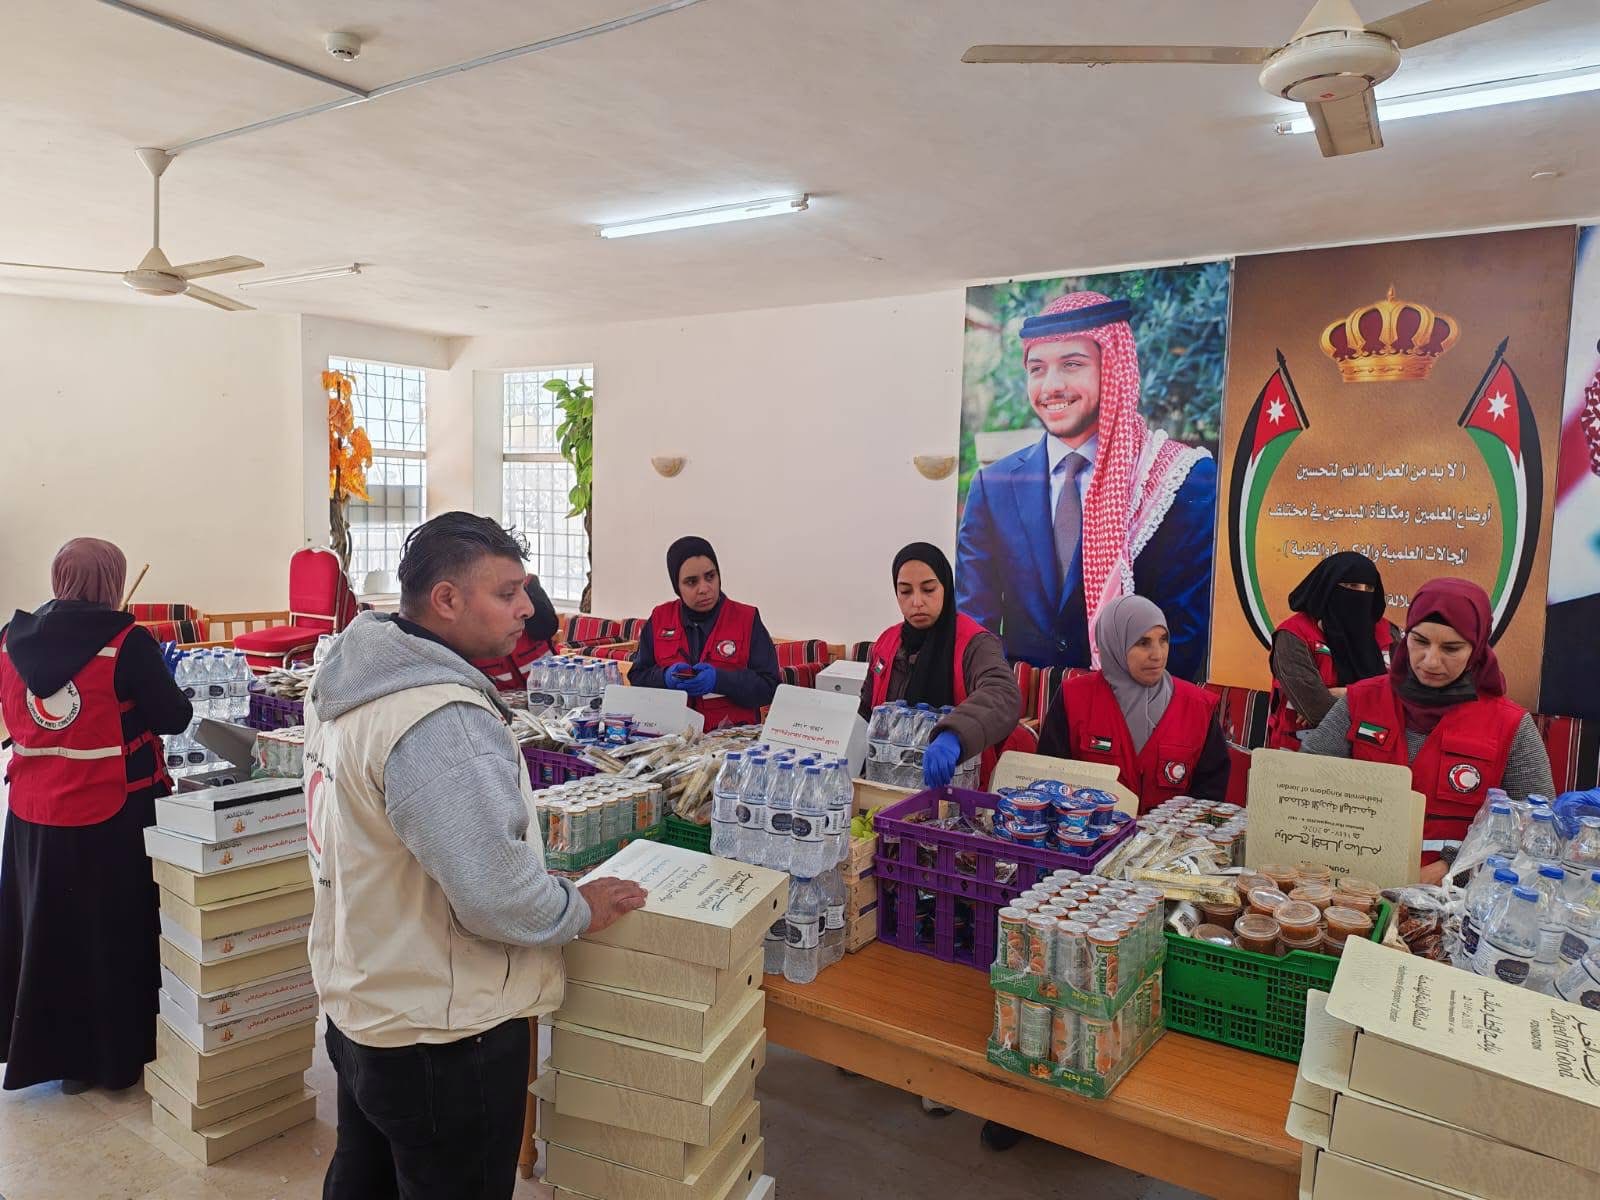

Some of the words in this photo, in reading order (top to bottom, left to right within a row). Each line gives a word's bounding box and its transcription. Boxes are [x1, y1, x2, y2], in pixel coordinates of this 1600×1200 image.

[1296, 463, 1338, 481] لتحسين
[1376, 463, 1409, 482] العمل
[1410, 465, 1427, 482] من
[1269, 502, 1308, 518] مختلف
[1309, 502, 1322, 520] في
[1324, 503, 1365, 524] المبدعين
[1414, 505, 1456, 524] المعلمين
[1457, 506, 1491, 529] أوضاع
[1381, 543, 1424, 561] العلمية
[1425, 545, 1468, 565] المجالات
[1276, 783, 1300, 791] Jordan
[1309, 788, 1342, 797] Kingdom
[1274, 829, 1310, 845] برنامج
[1343, 843, 1382, 856] صائم
[1547, 1008, 1574, 1039] Zayed
[1554, 1036, 1574, 1052] for
